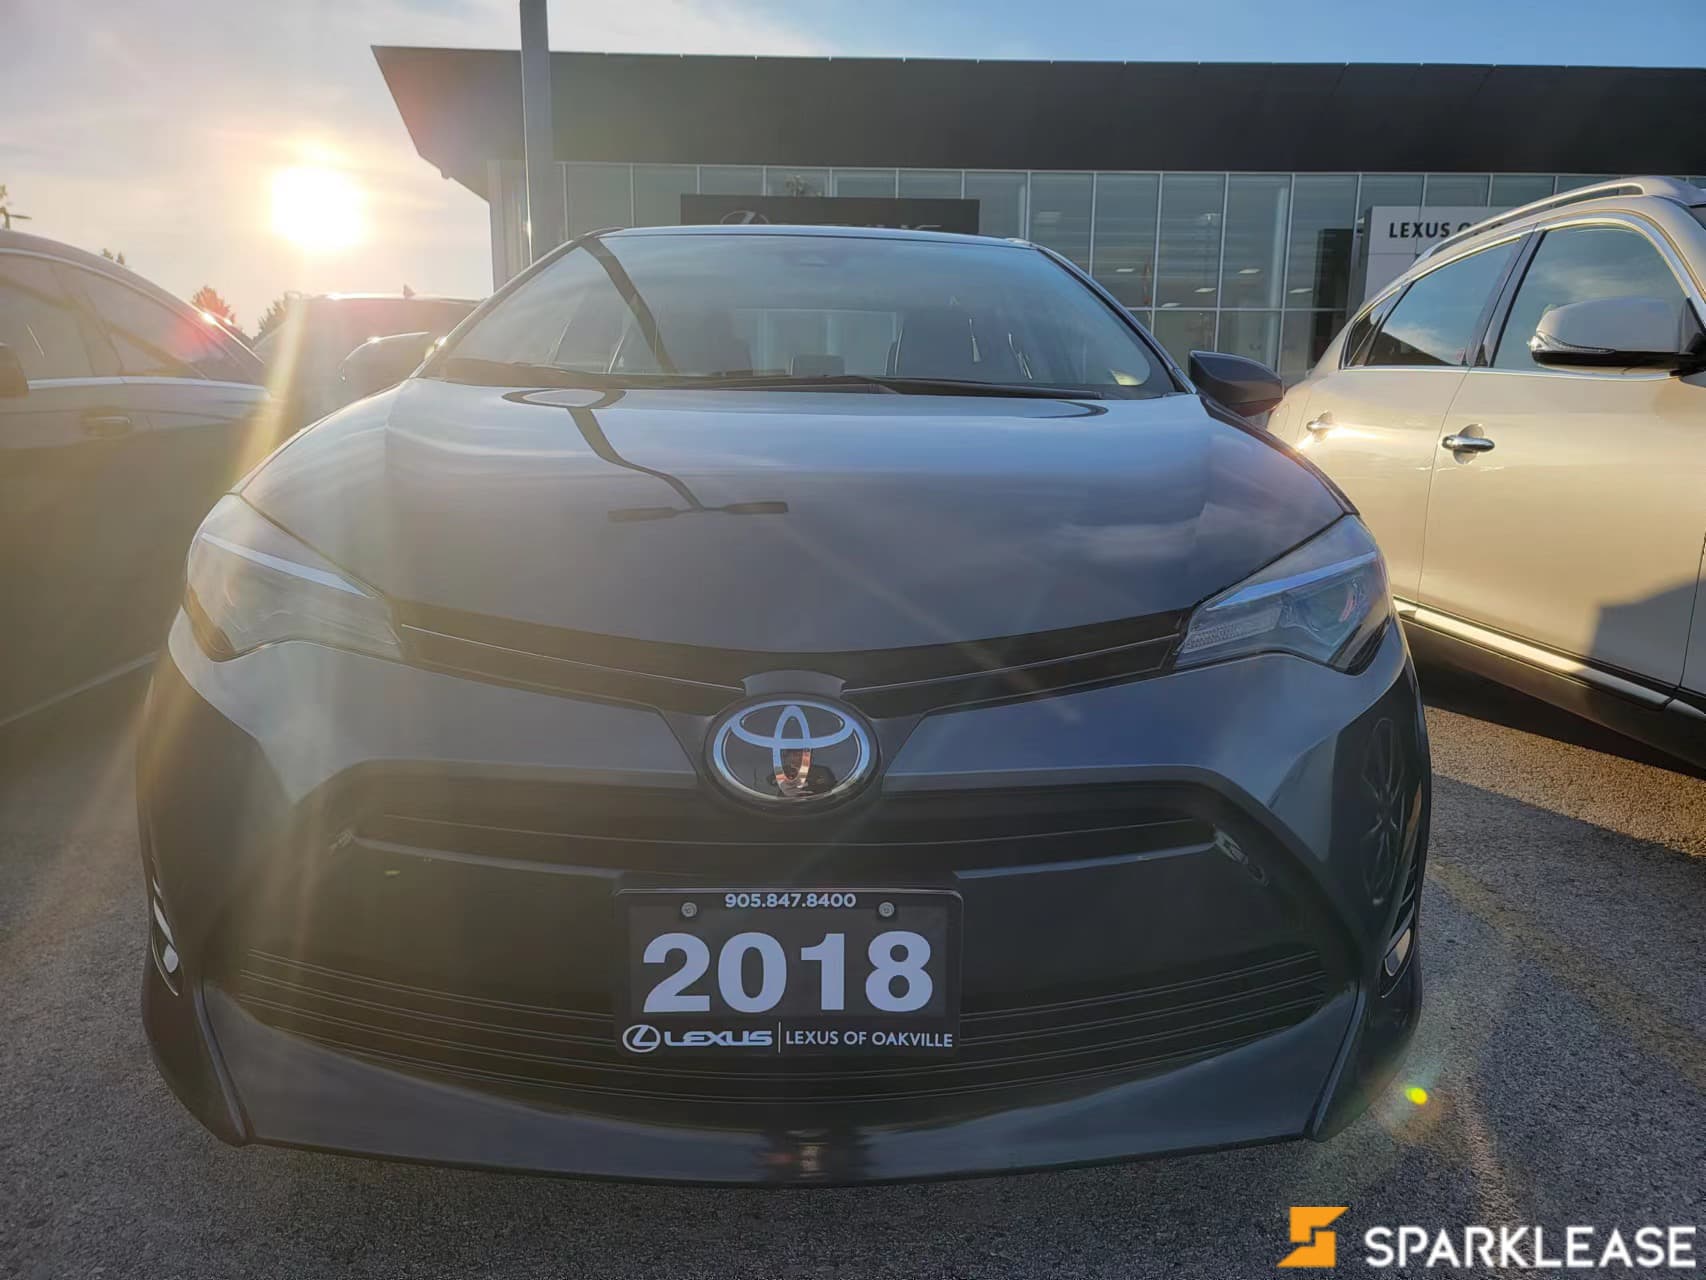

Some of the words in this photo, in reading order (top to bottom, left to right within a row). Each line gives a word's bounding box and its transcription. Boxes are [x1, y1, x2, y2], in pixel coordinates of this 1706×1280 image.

[1389, 222, 1450, 238] LEXUS
[724, 893, 857, 908] 905.847.8400
[642, 931, 934, 1013] 2018
[664, 1030, 773, 1047] LEXUS
[785, 1030, 839, 1046] LEXUS
[844, 1031, 867, 1046] OF
[872, 1031, 953, 1048] OAKVILLE
